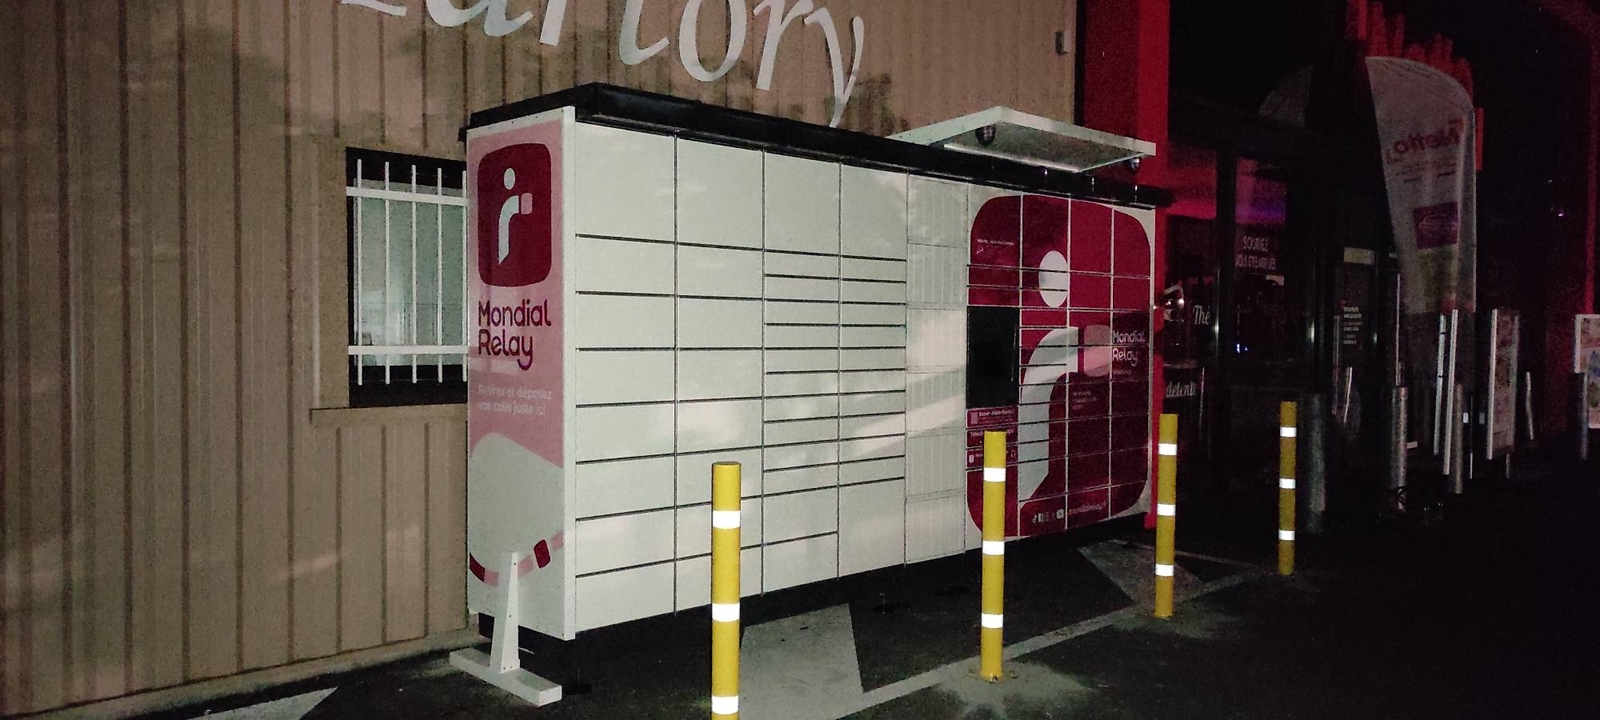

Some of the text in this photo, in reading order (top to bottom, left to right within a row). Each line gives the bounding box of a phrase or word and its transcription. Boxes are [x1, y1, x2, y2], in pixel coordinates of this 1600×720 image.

[478, 299, 552, 327] Mondial
[1193, 304, 1211, 326] Thé
[1112, 329, 1146, 343] Mondial
[478, 329, 533, 371] Relay
[1112, 347, 1138, 367] Relay
[506, 386, 515, 398] et
[516, 386, 552, 401] déposez
[478, 402, 490, 411] vos
[512, 401, 534, 416] juste
